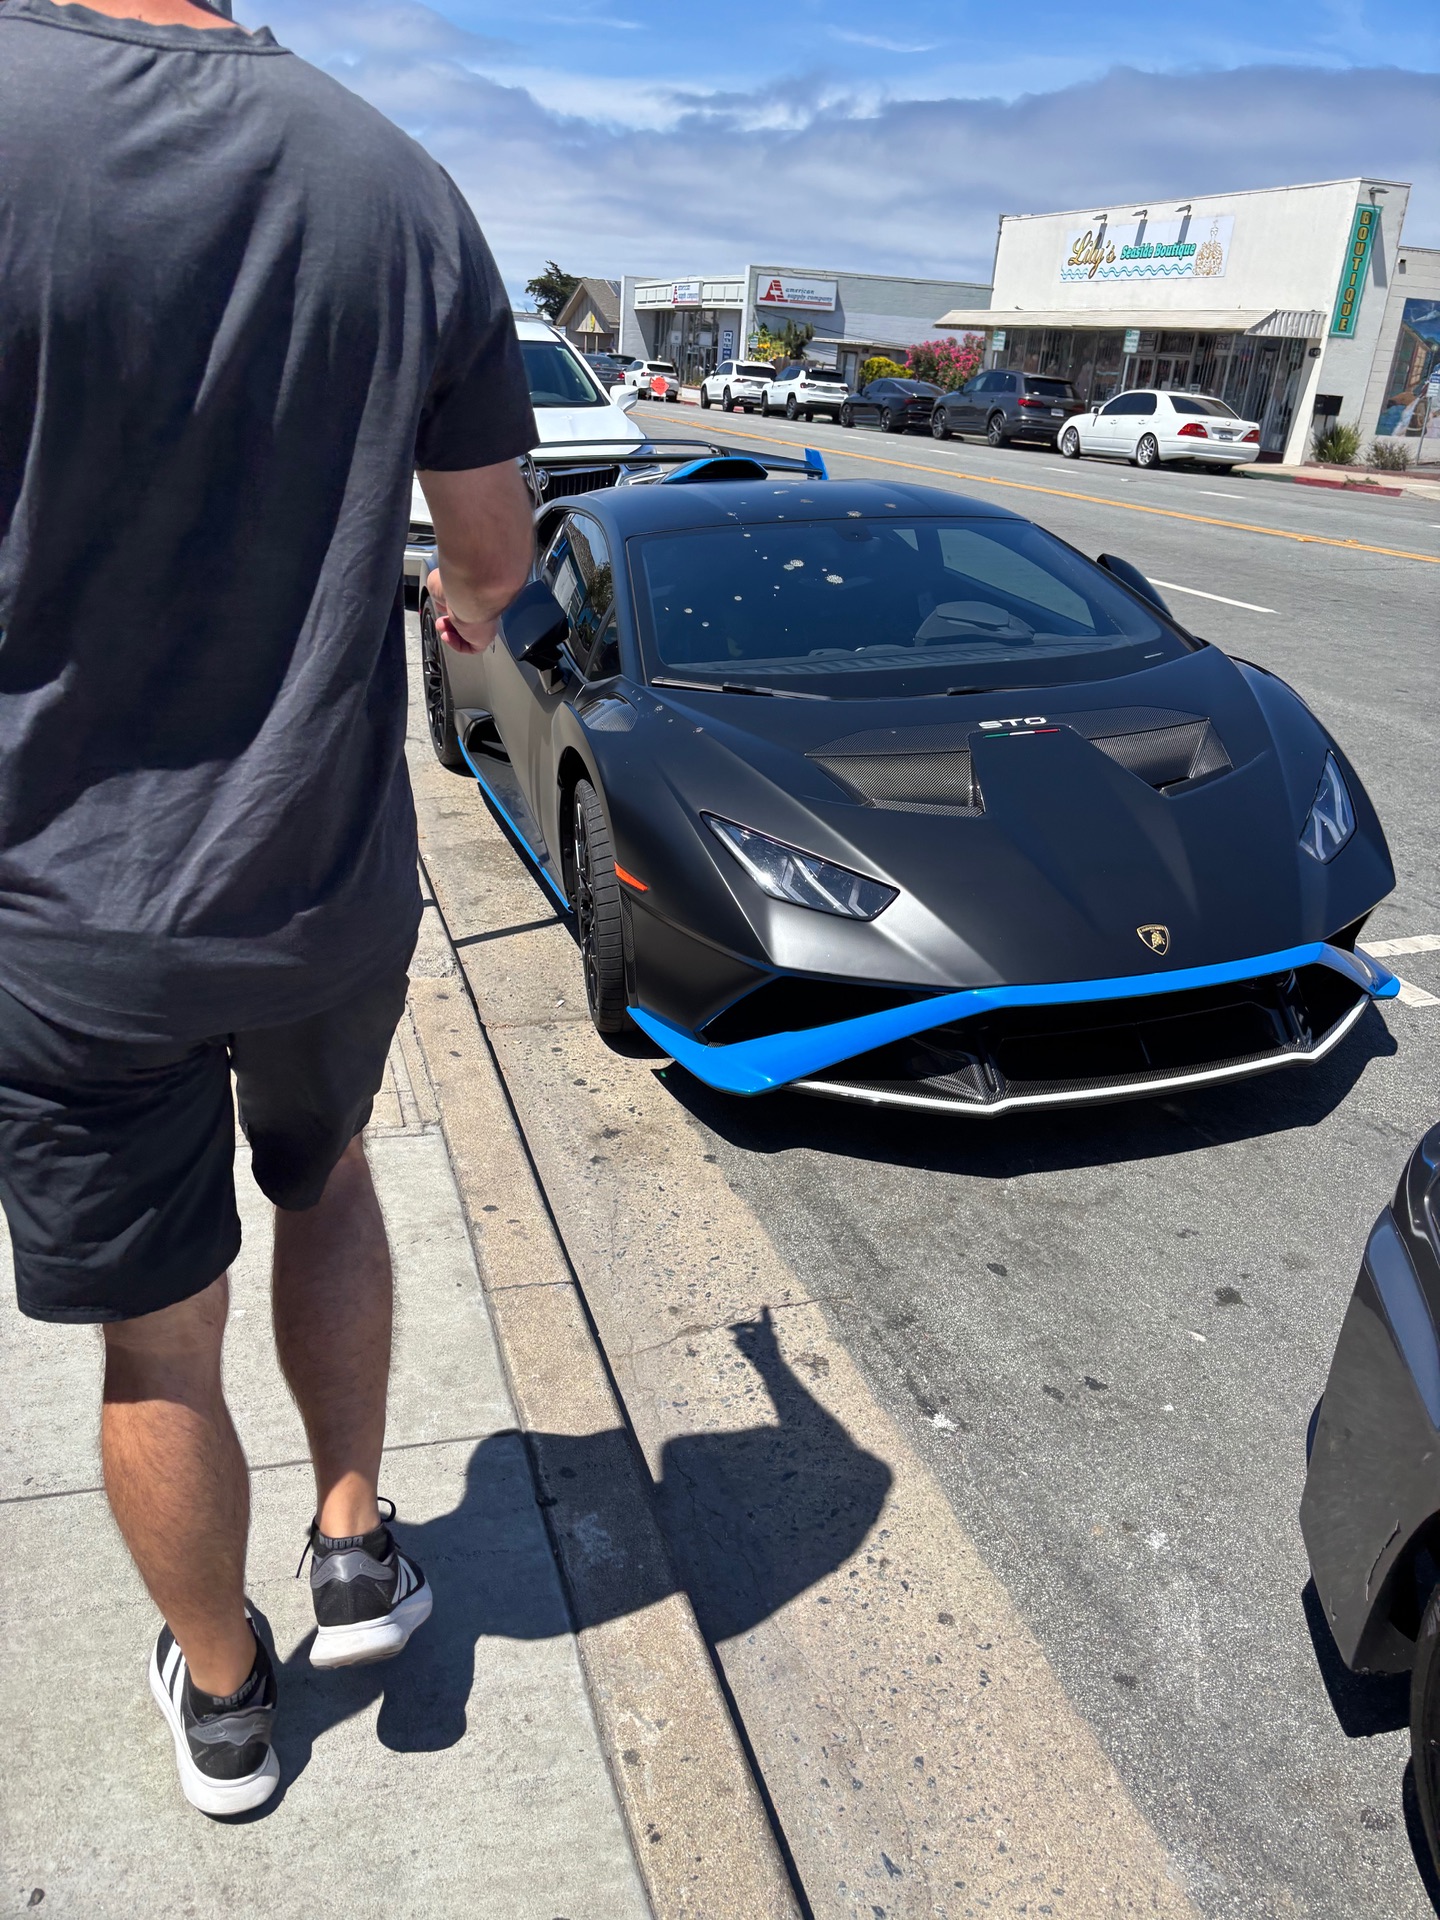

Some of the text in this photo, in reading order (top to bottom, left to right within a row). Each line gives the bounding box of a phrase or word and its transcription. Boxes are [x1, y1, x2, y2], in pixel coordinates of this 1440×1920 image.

[1068, 230, 1197, 279] Lily's Seaside Boutique
[1338, 210, 1373, 332] BOUTIQUE
[978, 716, 1047, 729] STO
